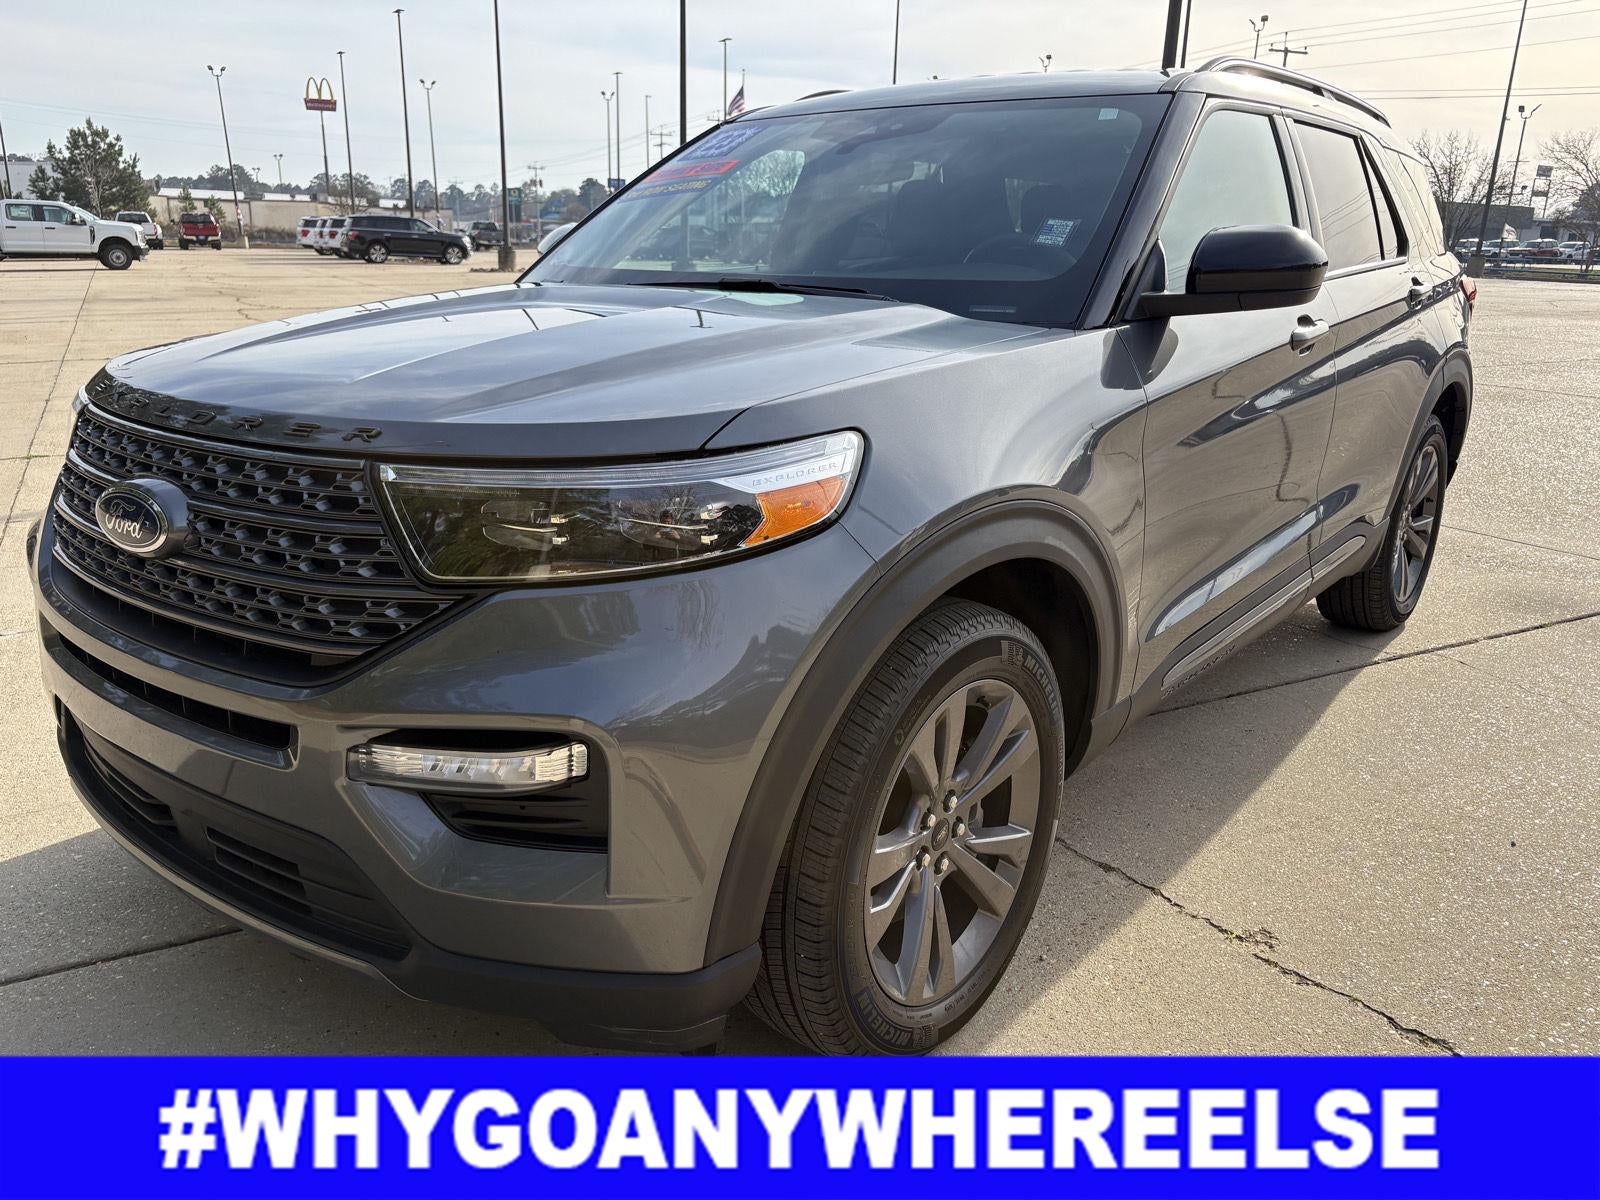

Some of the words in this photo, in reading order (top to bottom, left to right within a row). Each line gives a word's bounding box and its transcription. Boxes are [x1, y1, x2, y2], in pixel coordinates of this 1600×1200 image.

[752, 462, 838, 486] EXPLORER
[105, 499, 145, 539] Ford
[859, 992, 912, 1046] MICHELIN
